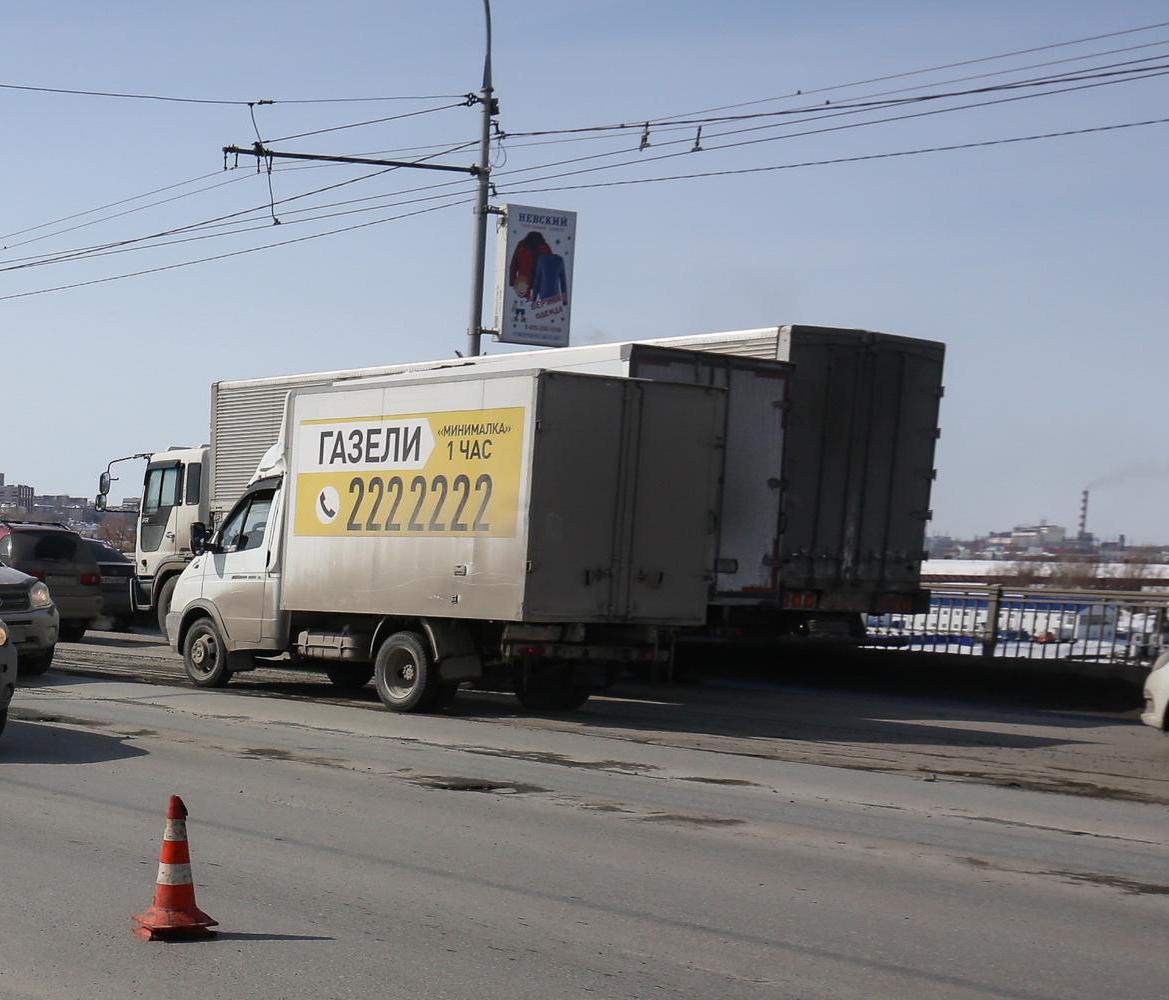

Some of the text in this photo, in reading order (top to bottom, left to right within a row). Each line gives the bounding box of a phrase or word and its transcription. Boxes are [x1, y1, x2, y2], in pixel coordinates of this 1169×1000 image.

[517, 212, 568, 227] НЕВСКИЙ
[535, 306, 563, 320] ОДЕЖДА
[437, 422, 512, 437] «МИНИМАЛКА»
[318, 426, 422, 465] ГАЗЕЛИ
[447, 438, 493, 460] 1 ЧАС
[346, 473, 493, 532] 2222222
